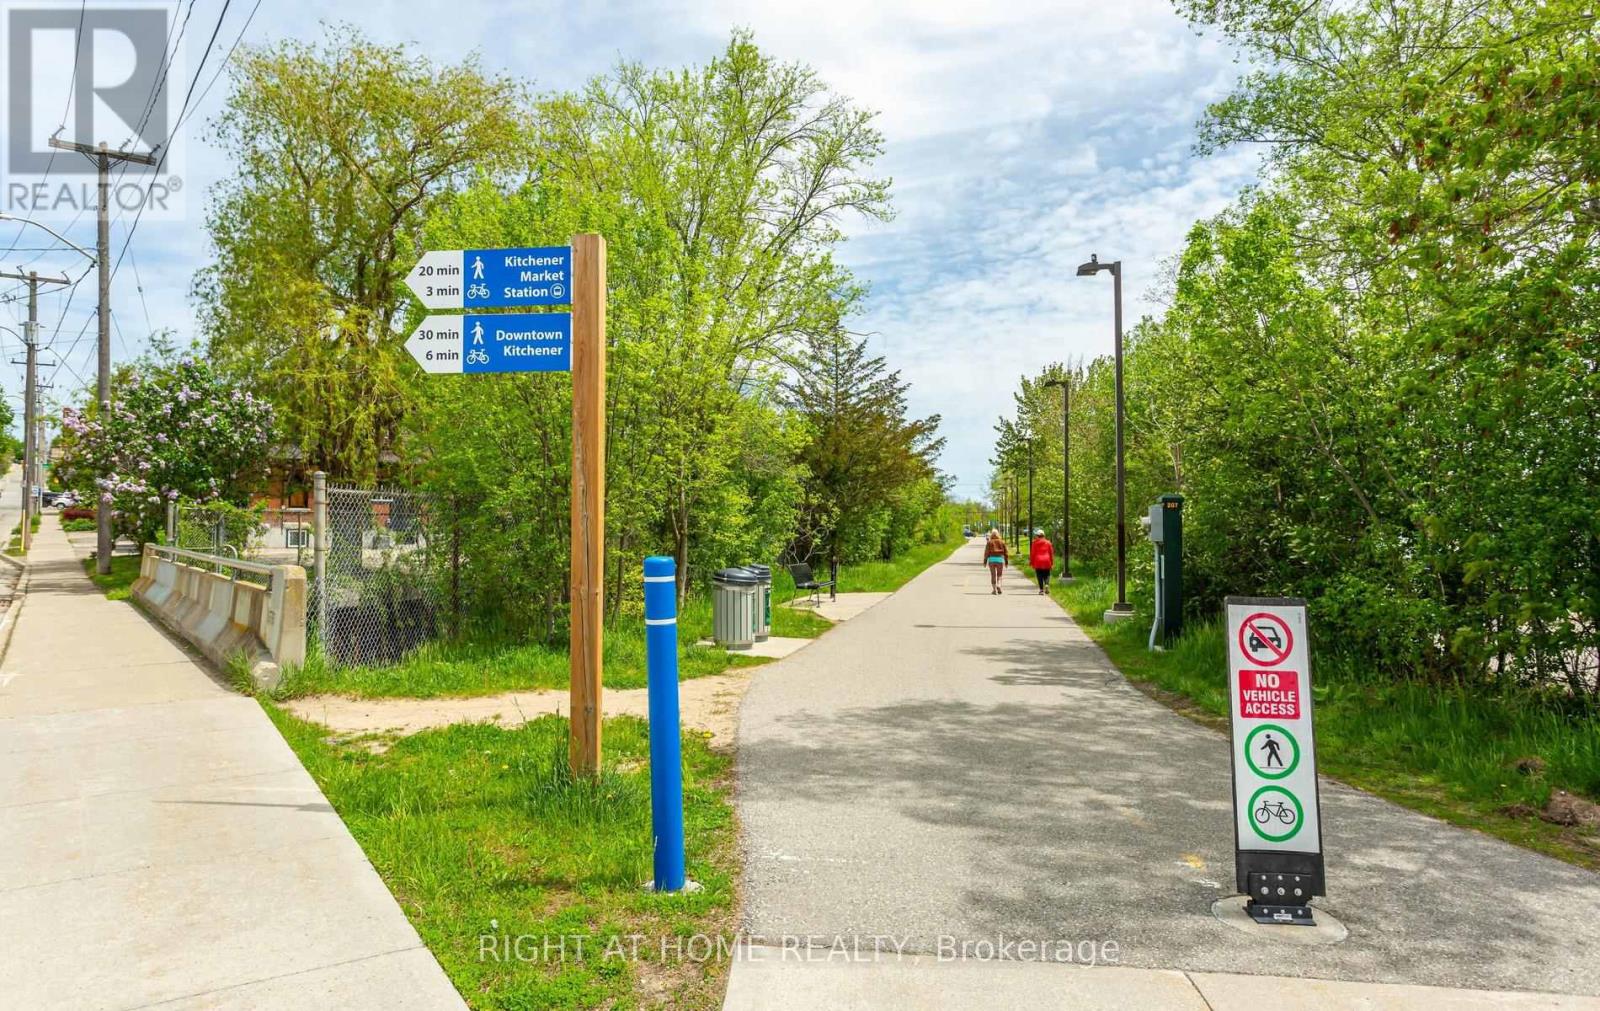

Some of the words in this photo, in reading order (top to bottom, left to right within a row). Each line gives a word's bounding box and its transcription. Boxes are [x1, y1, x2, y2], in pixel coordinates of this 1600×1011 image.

[504, 256, 564, 267] Kitchener
[418, 266, 433, 276] 20
[436, 265, 460, 275] min
[520, 271, 564, 282] Market
[426, 286, 433, 296] 3
[436, 285, 460, 296] min
[504, 287, 548, 298] Station
[418, 330, 433, 340] 30
[436, 329, 460, 339] min
[496, 330, 563, 341] Downtown
[425, 350, 433, 360] 6
[436, 350, 460, 360] min
[503, 345, 563, 356] Kitchener
[1255, 673, 1280, 688] NO
[1243, 690, 1296, 702] VEHICLE
[1245, 703, 1295, 715] ACCESS
